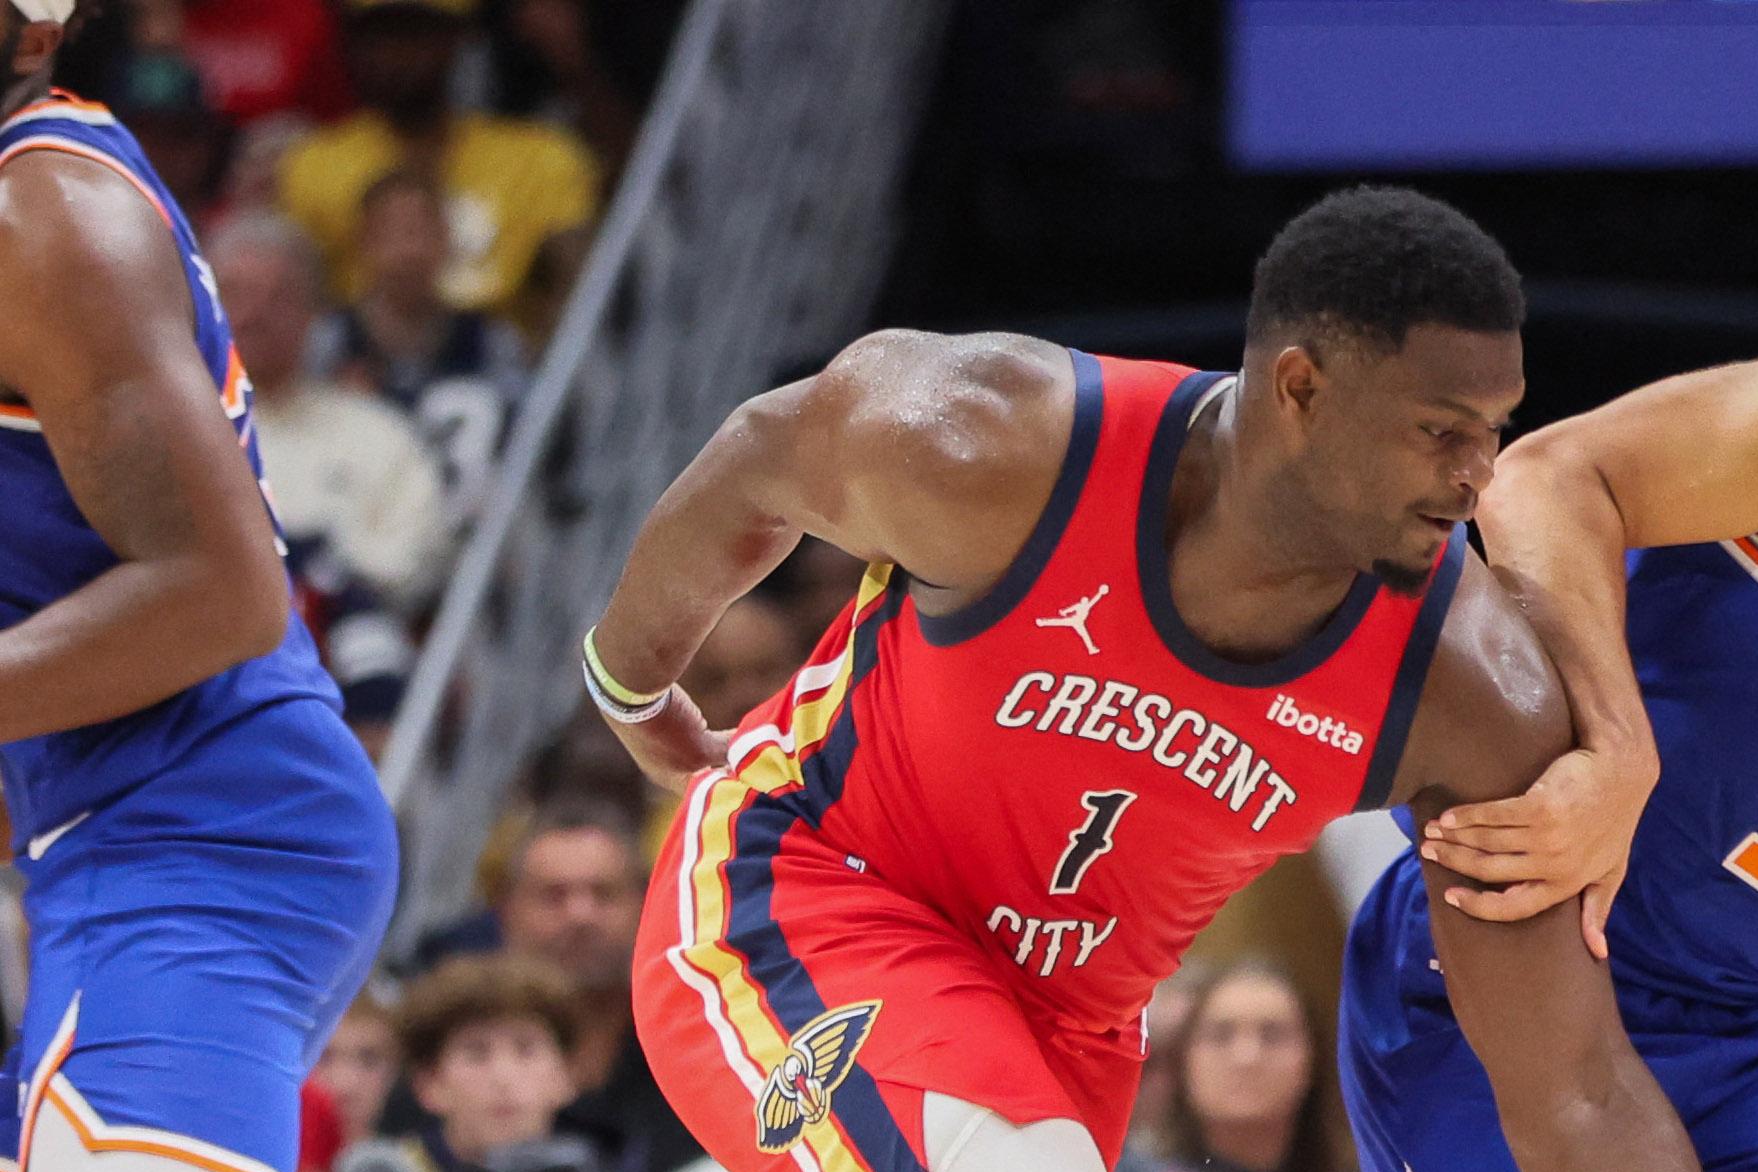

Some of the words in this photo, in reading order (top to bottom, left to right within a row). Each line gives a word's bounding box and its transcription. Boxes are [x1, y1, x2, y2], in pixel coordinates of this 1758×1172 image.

[995, 671, 1297, 832] CRESCENT
[1266, 693, 1364, 755] ibotta
[1049, 789, 1137, 895] 1
